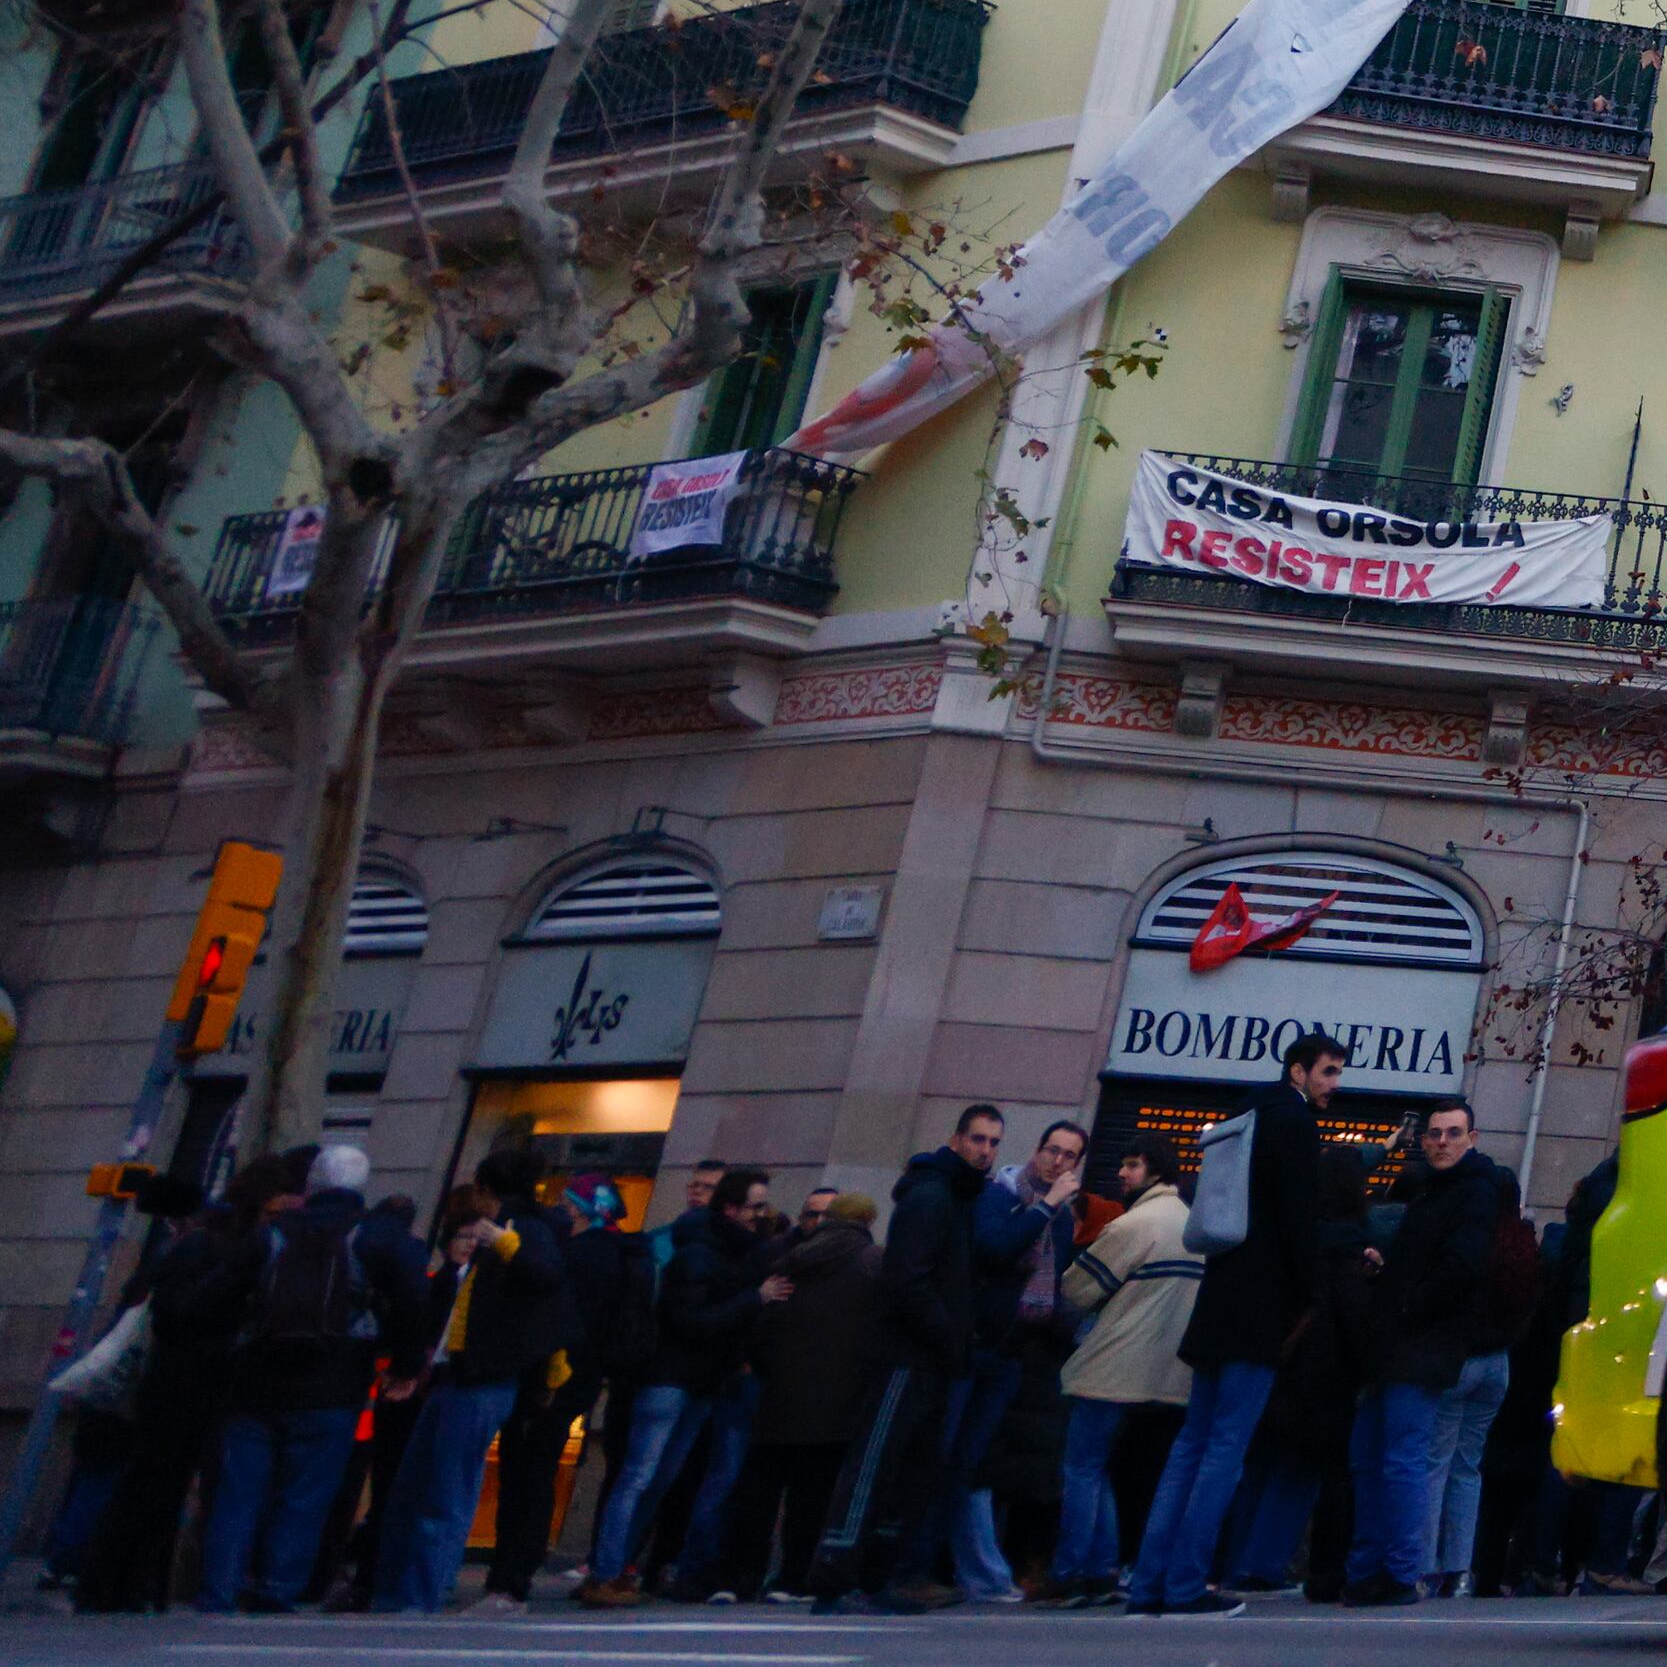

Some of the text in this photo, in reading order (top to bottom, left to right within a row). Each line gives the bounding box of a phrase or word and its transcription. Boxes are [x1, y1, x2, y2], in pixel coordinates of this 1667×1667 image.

[1166, 470, 1526, 549] CASA ORSOLA
[1160, 519, 1436, 600] RESISTEIX
